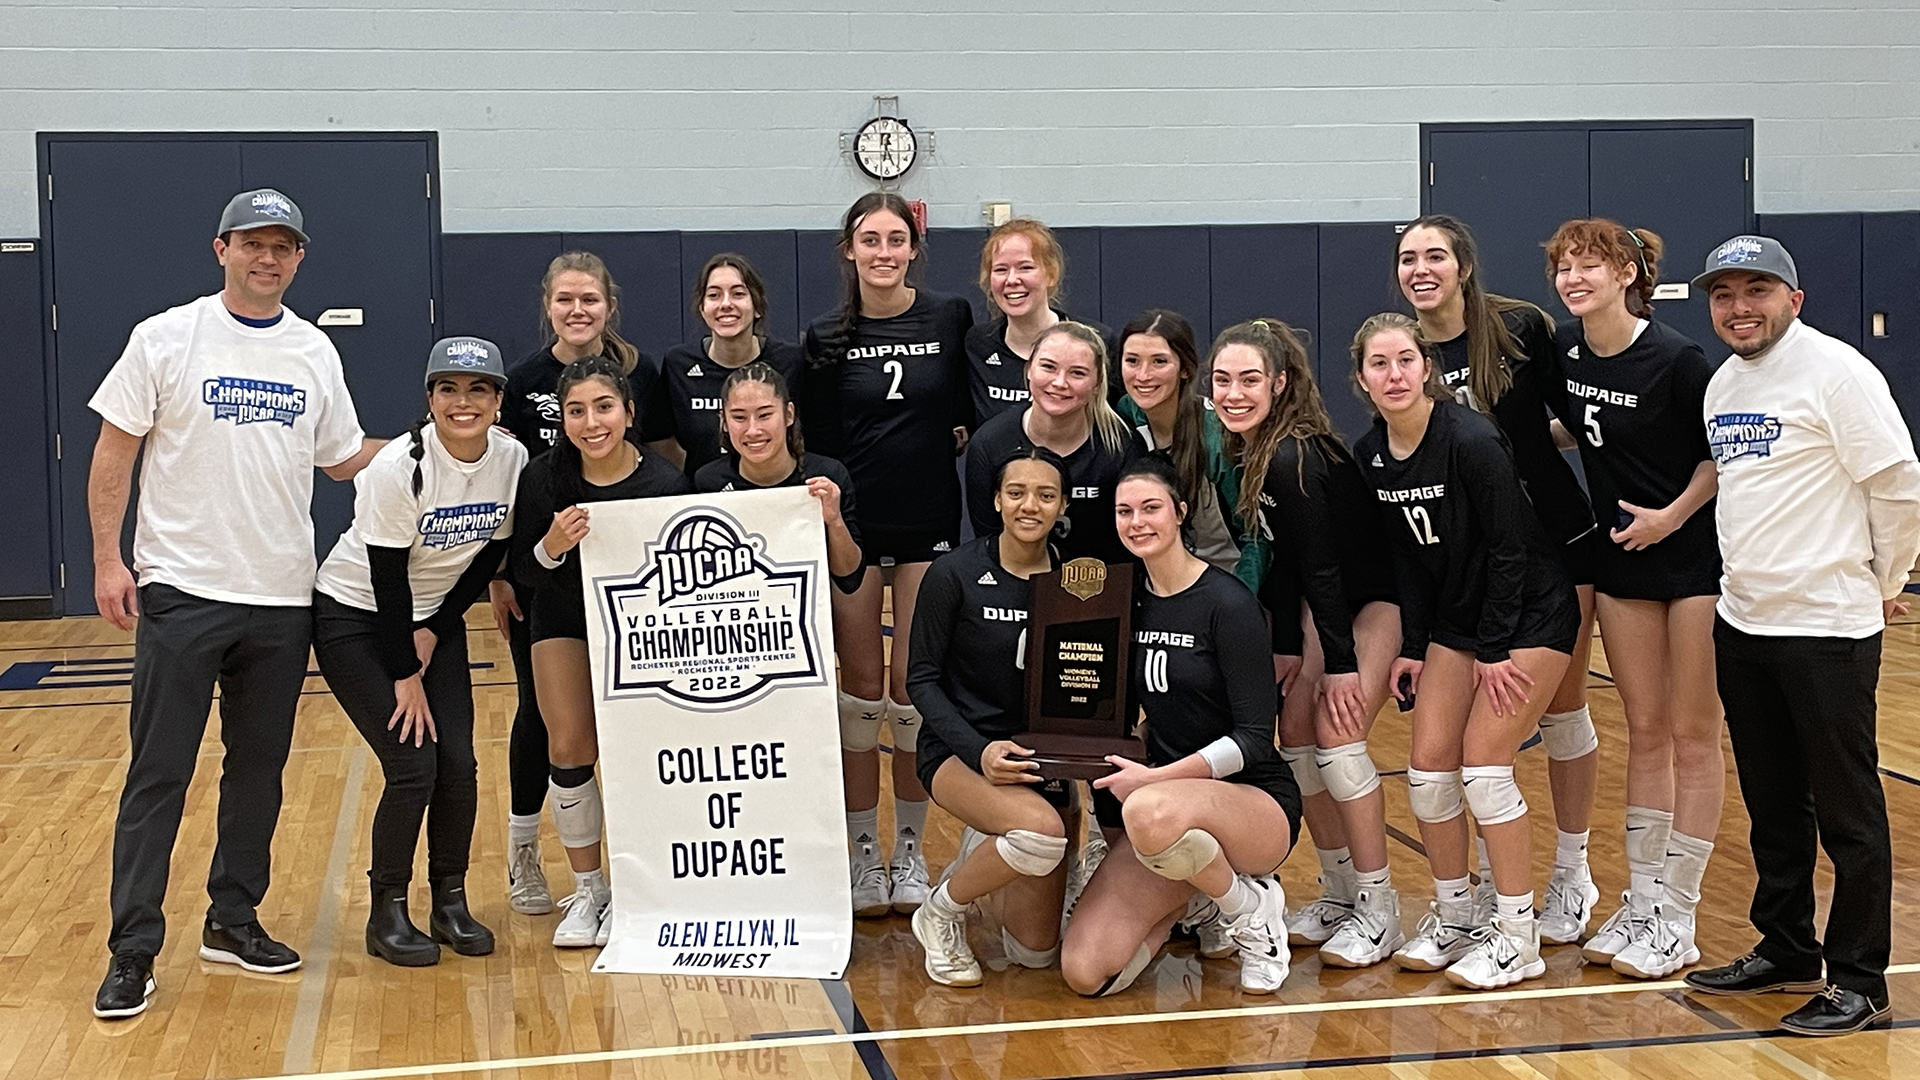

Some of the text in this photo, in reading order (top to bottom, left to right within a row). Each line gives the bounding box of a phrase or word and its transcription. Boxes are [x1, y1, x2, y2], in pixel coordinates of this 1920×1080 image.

[846, 342, 940, 360] DUPAGE
[224, 379, 289, 393] NATIONAL
[883, 360, 904, 400] 2
[205, 381, 305, 412] CHAMPIONS
[988, 386, 1034, 402] DUP
[1566, 379, 1638, 408] DUPAGE
[238, 404, 275, 423] NJCAA
[1584, 404, 1604, 447] 5
[1377, 484, 1445, 503] DUPAGE
[420, 507, 507, 534] CHAMPIONS
[1402, 506, 1440, 545] 12
[444, 530, 478, 550] NJCAA
[658, 547, 753, 600] NJCAA
[1063, 565, 1106, 585] NJCAA
[696, 589, 760, 601] DIVISION III
[627, 604, 792, 629] VOLLEYBALL
[628, 621, 794, 661] CHAMPIONSHIP
[1059, 641, 1104, 652] NATIONAL
[631, 653, 797, 670] ROCHESTER REGIONAL SPORTS CENTER
[1058, 651, 1104, 662] CHAMPION
[1059, 674, 1101, 683] VOLLEYBALL
[1063, 668, 1097, 676] WOMEN'S
[1144, 648, 1169, 693] 10
[689, 676, 741, 692] 2022
[1060, 681, 1091, 689] DIVISION
[658, 742, 787, 785] COLLEGE
[708, 792, 742, 829] OF
[671, 837, 786, 879] DUPAGE
[657, 918, 800, 949] GLEN ELLYN, IL
[672, 952, 772, 969] MIDWEST
